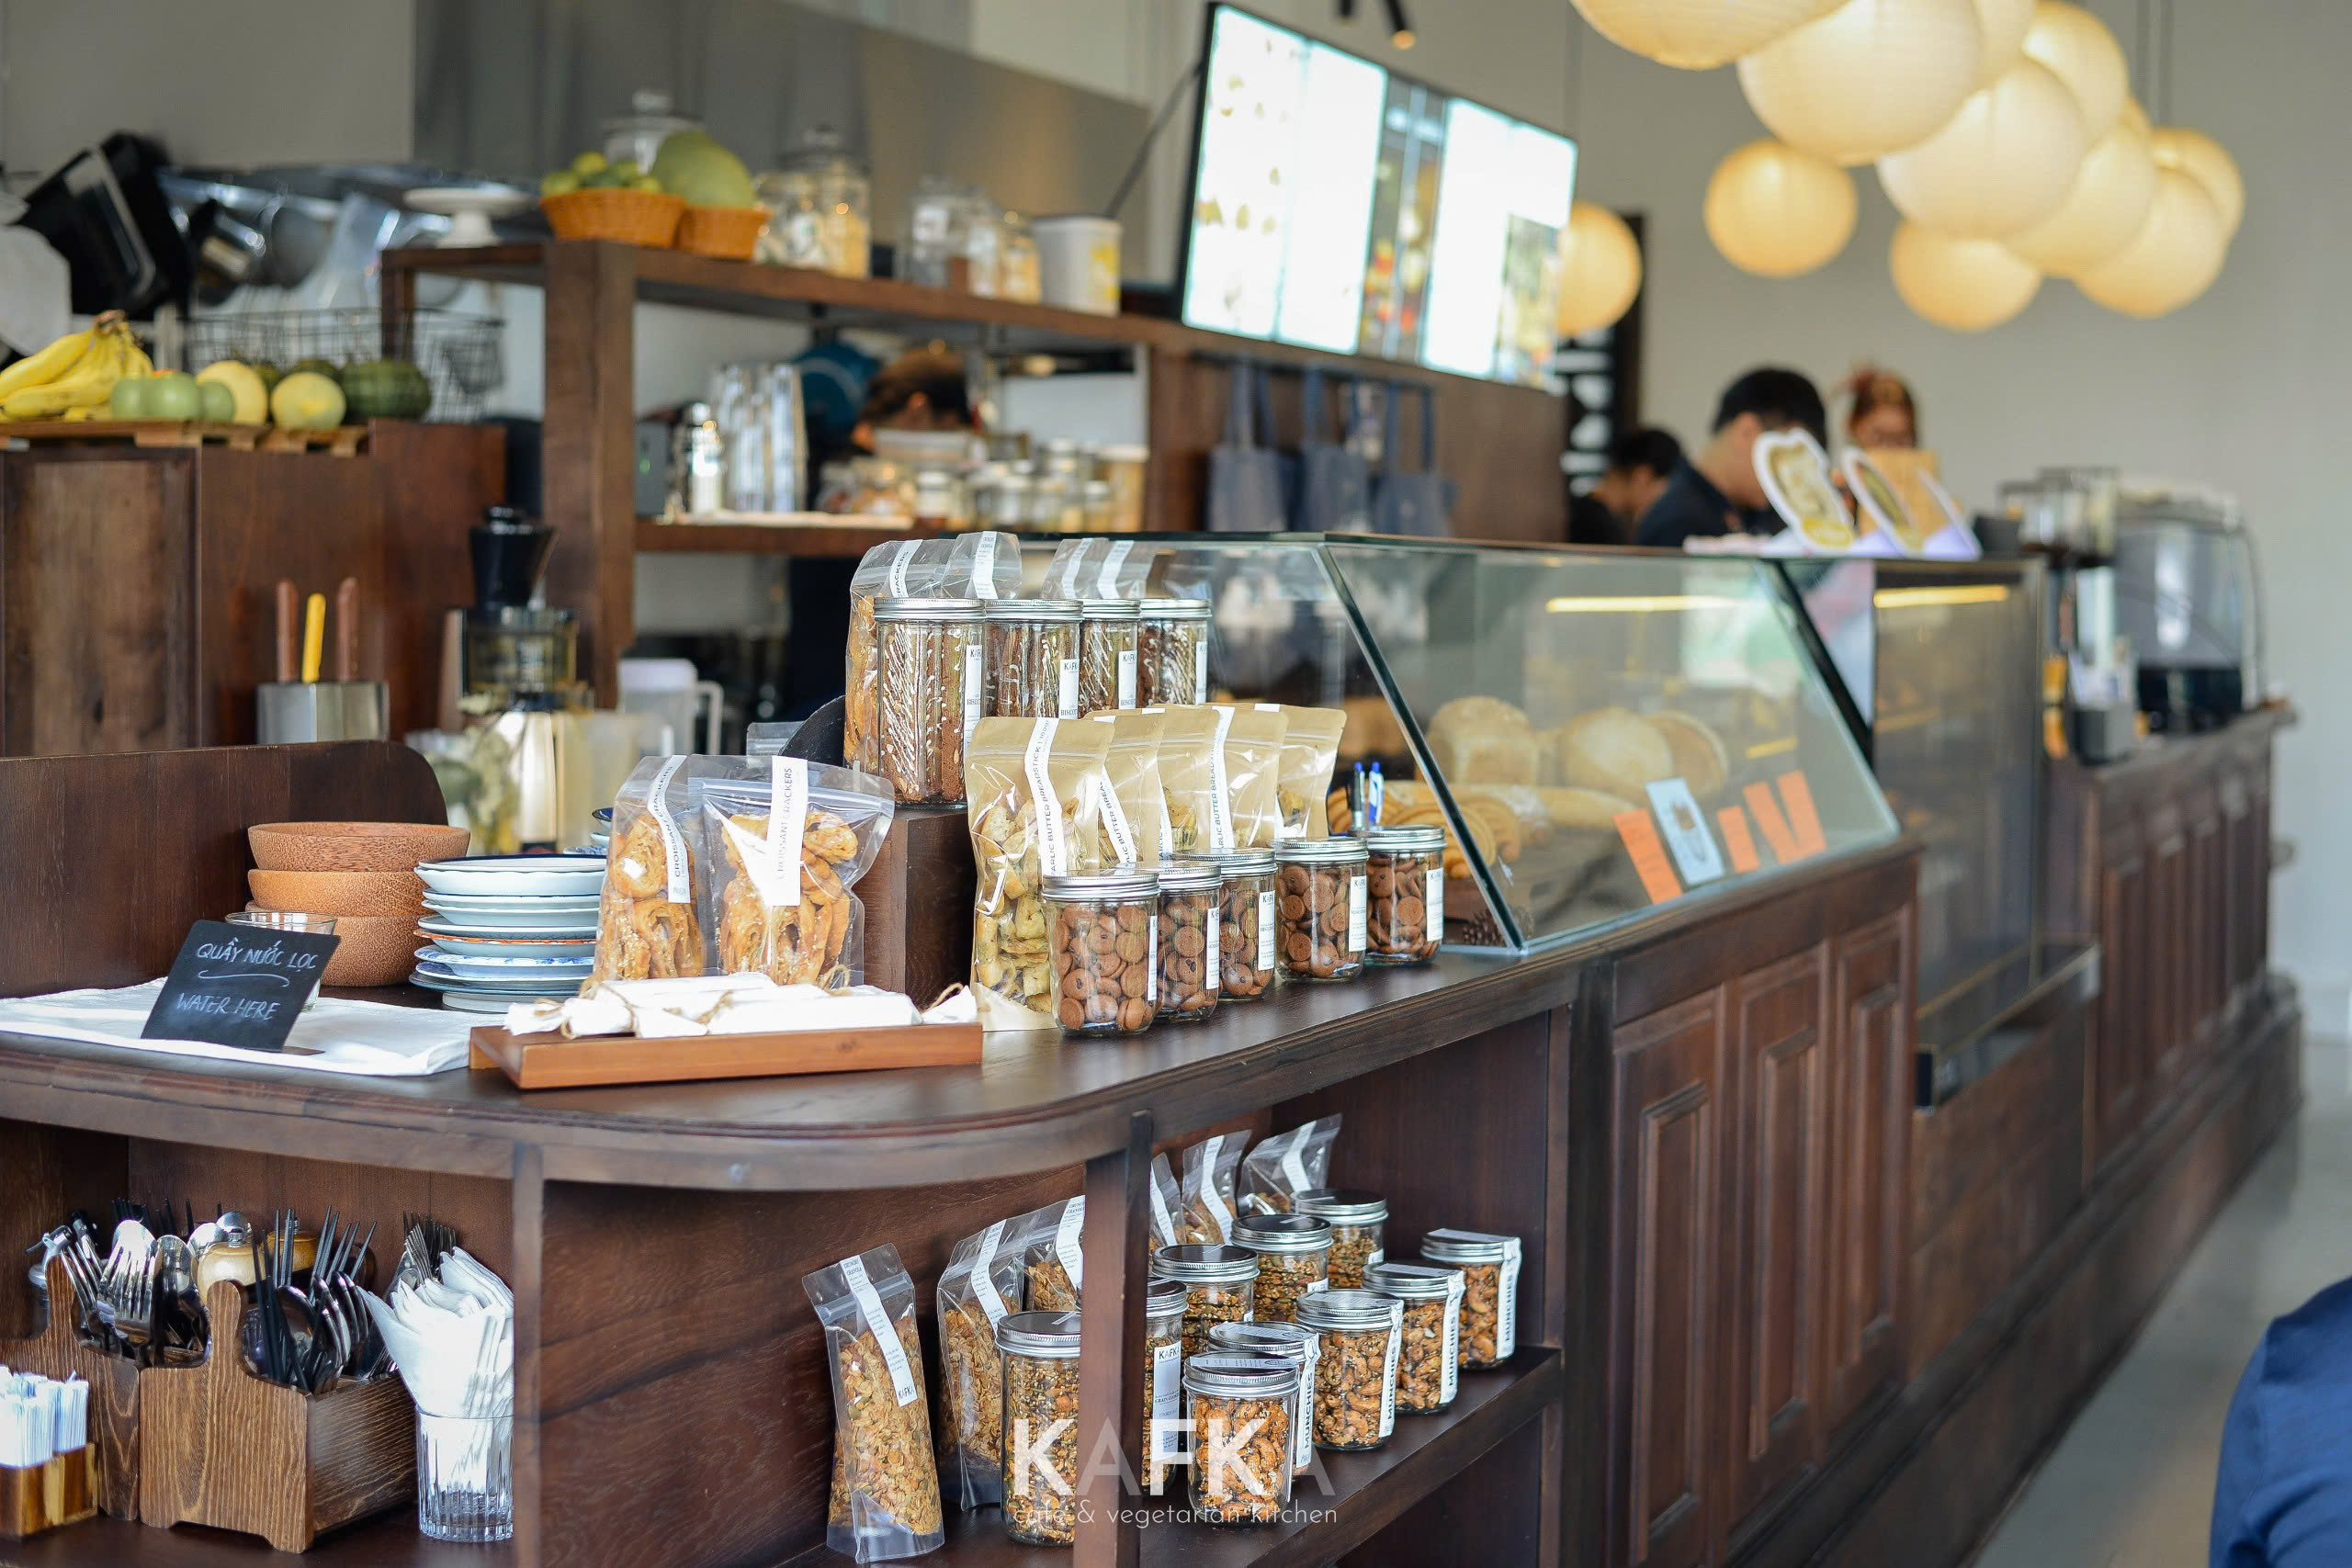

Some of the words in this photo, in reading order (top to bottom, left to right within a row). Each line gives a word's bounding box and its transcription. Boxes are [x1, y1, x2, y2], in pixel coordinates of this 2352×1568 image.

[1033, 744, 1049, 803] BREADSTICK
[1043, 804, 1054, 841] BUTTER
[1211, 794, 1221, 826] BUTTER
[287, 952, 319, 973] LỌC
[176, 992, 232, 1015] WATER
[233, 998, 281, 1021] HERE
[1505, 1273, 1513, 1341] MUNCHIES
[1448, 1316, 1456, 1386] MUNCHIES
[1304, 1371, 1314, 1450] MUNCHIES
[1387, 1346, 1396, 1420] MUNCHIES
